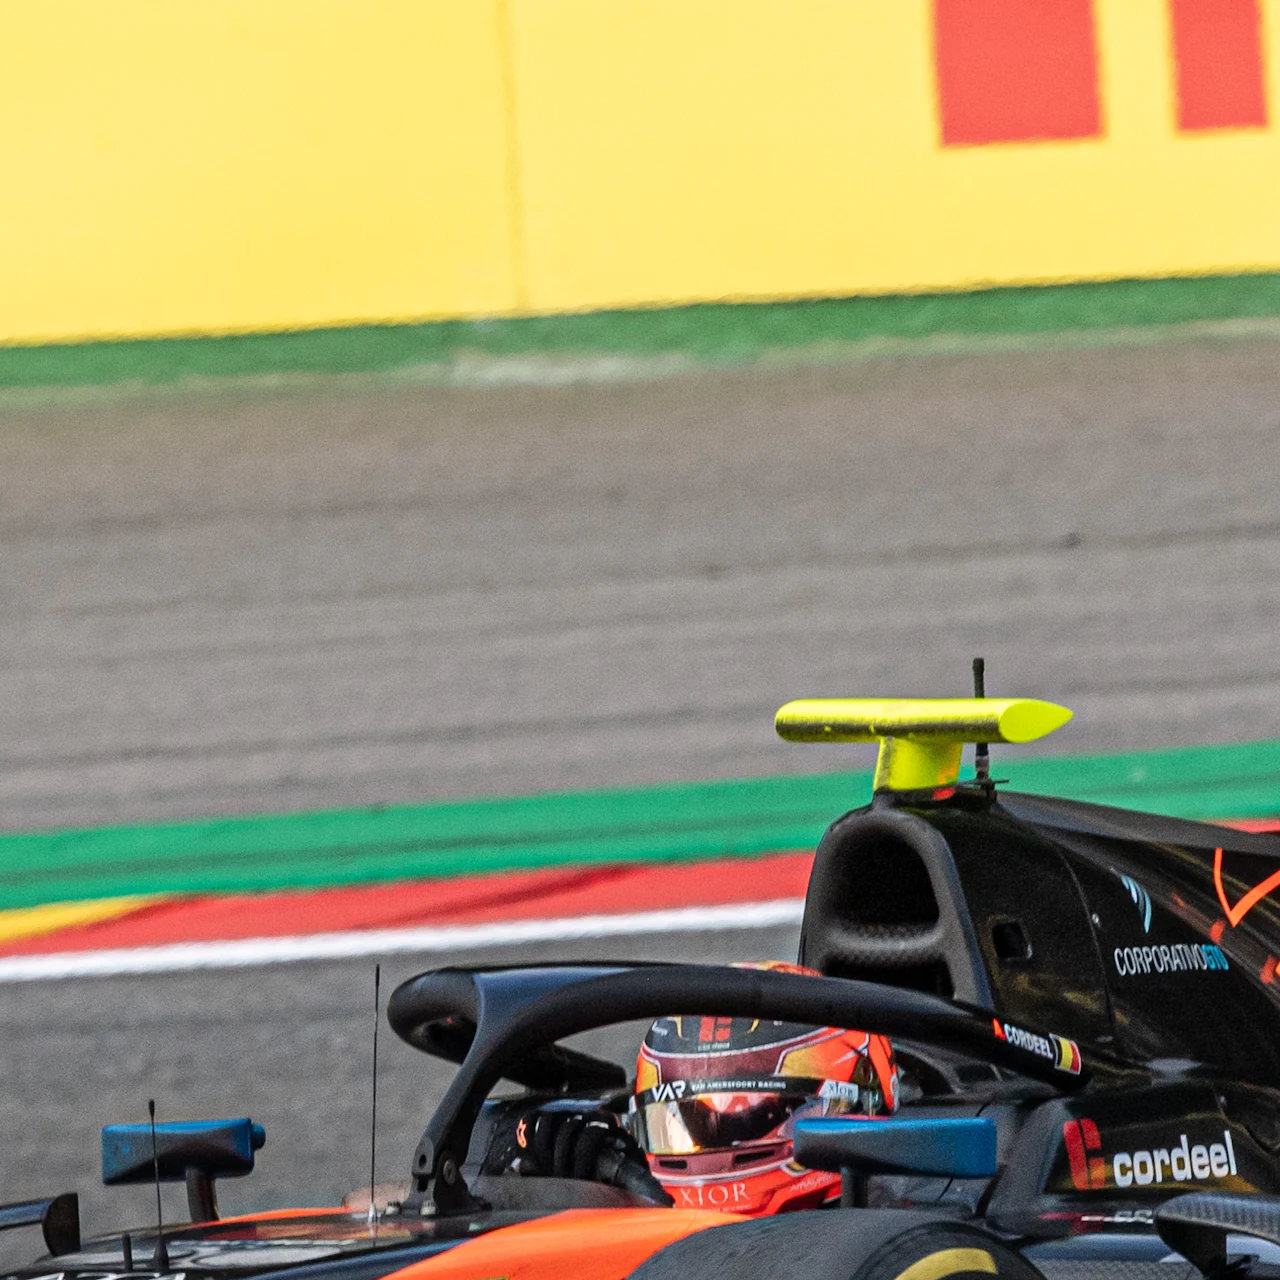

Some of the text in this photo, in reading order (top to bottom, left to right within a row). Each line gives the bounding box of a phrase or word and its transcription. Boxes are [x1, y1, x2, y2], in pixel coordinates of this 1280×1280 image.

[1003, 1023, 1054, 1060] CORDEEL
[652, 1080, 686, 1102] VAR
[1113, 1130, 1237, 1188] cordeel
[680, 1183, 749, 1207] XIOR
